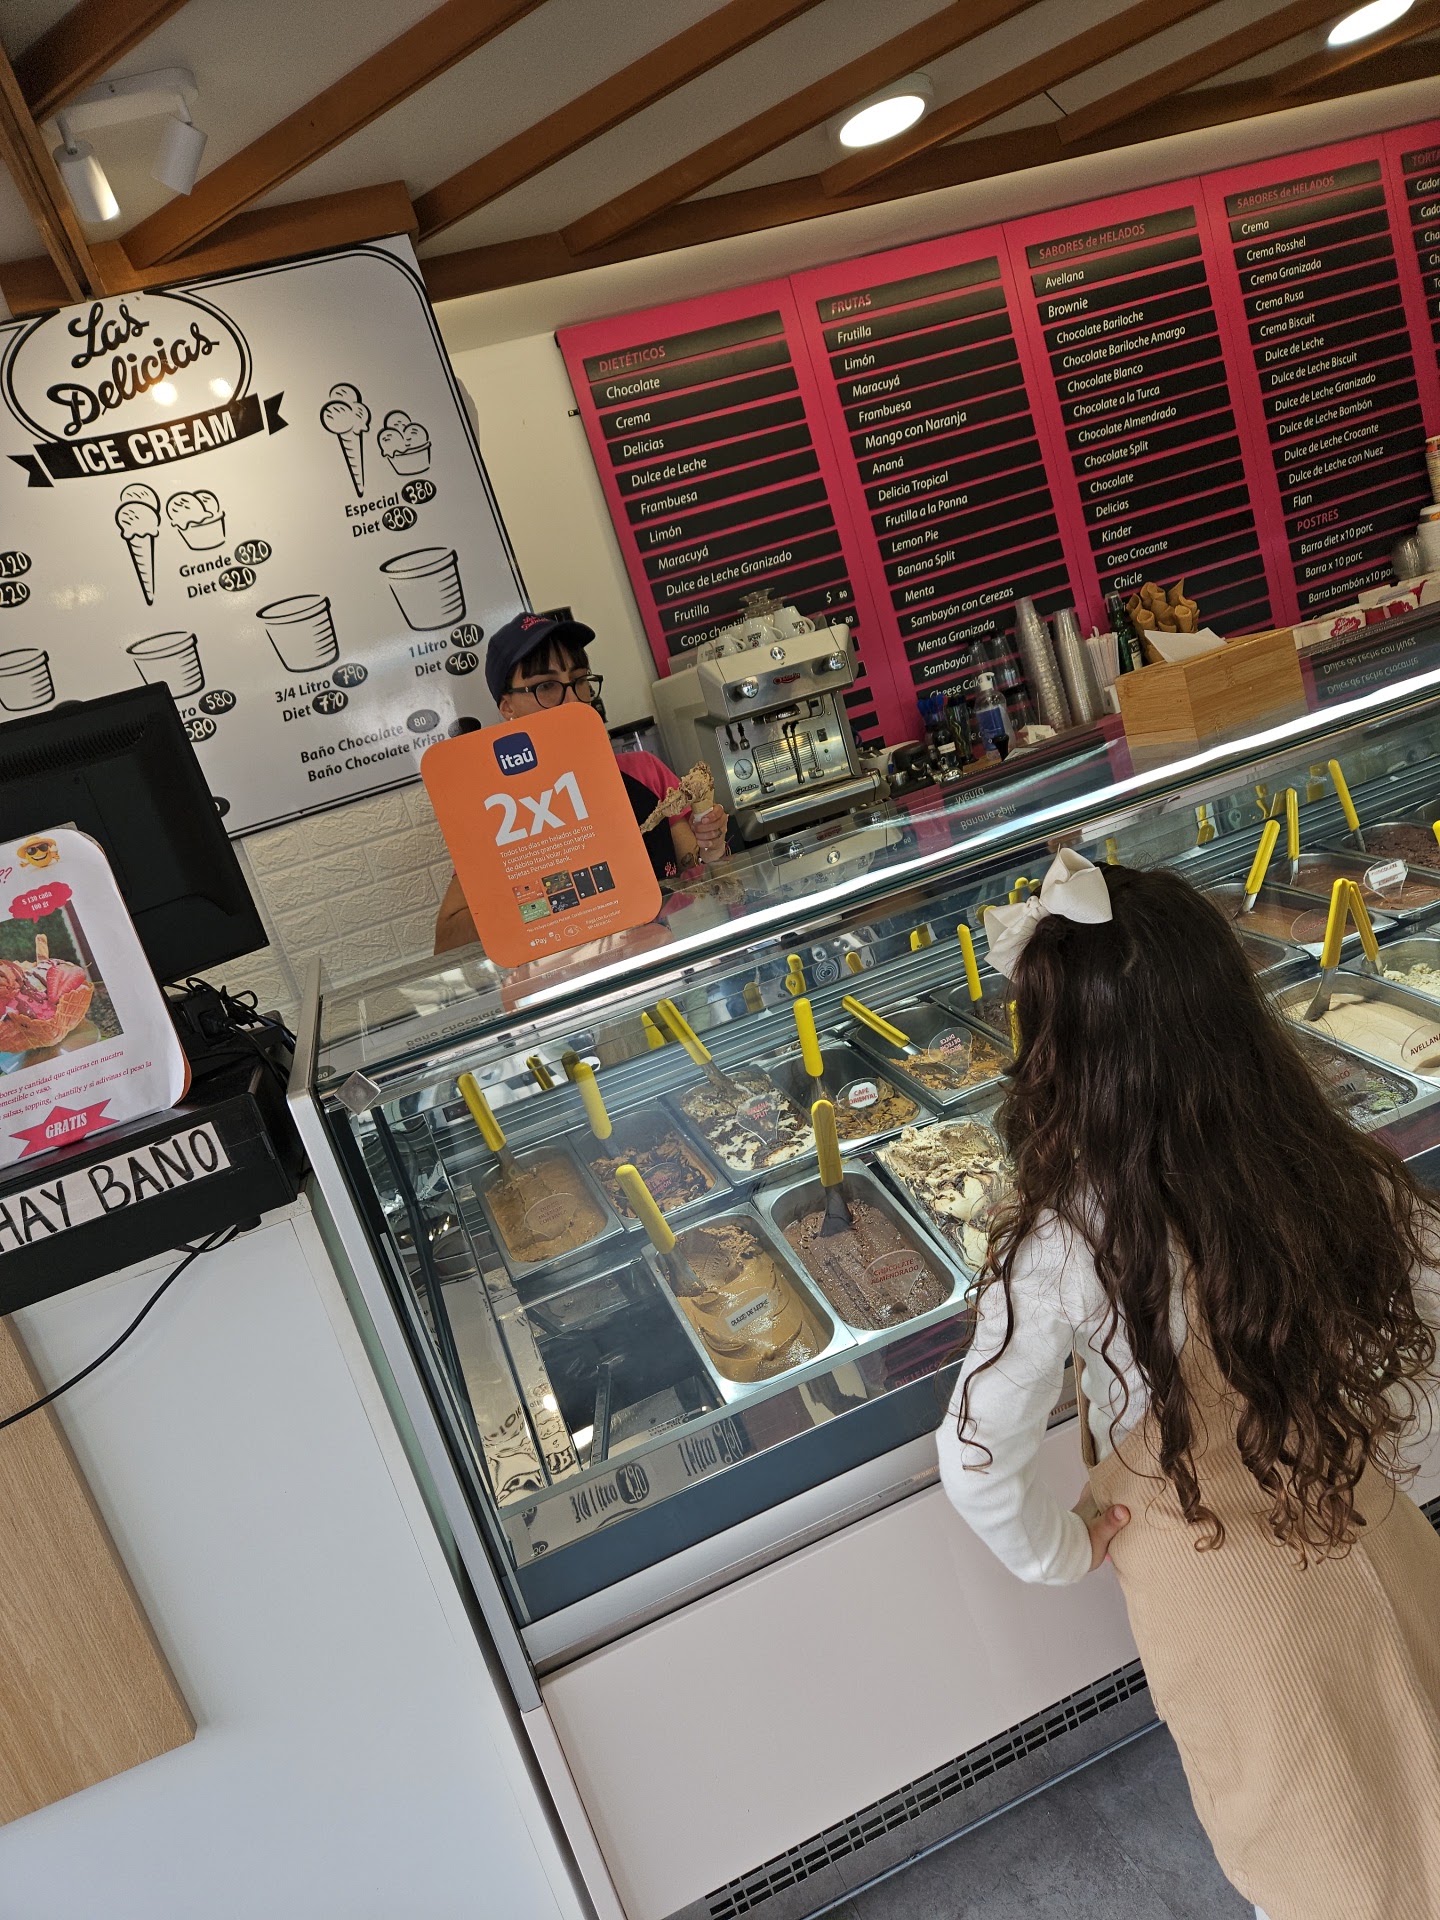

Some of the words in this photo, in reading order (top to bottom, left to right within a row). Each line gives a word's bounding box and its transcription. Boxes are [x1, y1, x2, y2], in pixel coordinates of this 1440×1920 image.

[1236, 191, 1278, 209] SABORES
[1279, 186, 1291, 198] de
[1292, 177, 1338, 197] HELADOS
[1240, 220, 1269, 234] Crema
[1038, 240, 1084, 259] SABORES
[1085, 235, 1097, 248] de
[1098, 224, 1147, 244] HELADOS
[1245, 246, 1274, 261] Crema
[1274, 235, 1306, 253] Rosshel
[1044, 270, 1084, 288] Avellana
[1249, 271, 1278, 286] Crema
[1278, 258, 1321, 278] Granizada
[830, 296, 871, 313] FRUTAS
[1047, 296, 1088, 318] Brownie
[1254, 296, 1283, 311] Crema
[1283, 290, 1304, 303] Rusa
[67, 301, 150, 369] Las
[837, 324, 872, 343] Frutilla
[1055, 323, 1101, 344] Chocolate
[1102, 310, 1144, 331] Bariloche
[1259, 321, 1287, 337] Crema
[1287, 312, 1315, 329] Biscuit
[598, 346, 666, 372] DIETÉTICOS
[1062, 348, 1107, 368] Chocolate
[1108, 335, 1149, 355] Bariloche
[1150, 325, 1186, 343] Amargo
[844, 353, 875, 371] Limón
[46, 321, 220, 437] Delicias
[605, 377, 660, 399] Chocolate
[852, 373, 900, 397] Maracuyá
[1066, 372, 1112, 393] Chocolate
[1112, 363, 1143, 380] Blanco
[615, 411, 651, 429] Crema
[858, 399, 911, 423] Frambuesa
[1077, 422, 1122, 442] Chocolate
[1123, 405, 1177, 430] Almendrado
[71, 439, 126, 474] ICE
[127, 410, 237, 465] CREAM
[864, 429, 903, 449] Mango
[903, 423, 923, 437] con
[924, 410, 967, 432] Naranja
[622, 438, 664, 457] Delicias
[1083, 447, 1128, 468] Chocolate
[1128, 440, 1148, 456] Split
[630, 470, 661, 487] Dulce
[662, 465, 676, 478] de
[676, 457, 707, 475] Leche
[871, 455, 904, 475] Ananá
[877, 483, 910, 501] Delicia
[910, 470, 948, 491] Tropical
[1089, 472, 1134, 493] Chocolate
[344, 491, 400, 518] Especial
[404, 481, 434, 505] 380
[640, 490, 698, 515] Frambuesa
[884, 508, 918, 527] Frutilla
[918, 507, 926, 516] a
[926, 502, 936, 514] la
[937, 494, 968, 511] Panna
[1095, 499, 1129, 517] Delicias
[1292, 493, 1312, 508] Flan
[351, 520, 381, 538] Diet
[384, 506, 415, 530] 380
[1101, 525, 1132, 542] Kinder
[1296, 510, 1339, 531] POSTRES
[648, 525, 682, 543] Limón
[891, 535, 923, 553] Lemon
[924, 529, 938, 542] Pie
[178, 554, 233, 578] Grande
[238, 540, 270, 564] 320
[658, 544, 709, 570] Maracuyá
[896, 558, 933, 577] Banana
[934, 550, 955, 566] Split
[1106, 552, 1129, 566] Oreo
[1129, 540, 1168, 559] Crocante
[1304, 563, 1327, 578] Barra
[1327, 561, 1333, 570] x
[1334, 555, 1344, 567] 10
[1344, 550, 1363, 566] porc
[186, 580, 218, 599] Diet
[221, 567, 254, 592] 320
[665, 580, 695, 596] Dulce
[696, 574, 709, 587] de
[710, 566, 739, 583] Leche
[740, 549, 792, 574] Granizado
[1113, 571, 1142, 589] Chicle
[904, 585, 935, 602] Menta
[673, 603, 709, 622] Frutilla
[910, 604, 960, 628] Sambayón
[960, 598, 978, 611] con
[978, 586, 1014, 605] Cerezas
[408, 644, 416, 659] 1
[416, 639, 448, 657] Litro
[451, 624, 479, 648] 960
[917, 635, 947, 652] Menta
[947, 619, 995, 642] Granizada
[414, 660, 442, 678] Diet
[448, 652, 478, 672] 960
[274, 686, 297, 704] 3/4
[298, 679, 331, 697] Litro
[337, 665, 365, 686] 790
[282, 704, 312, 723] Diet
[299, 745, 336, 764] Baño
[337, 724, 404, 752] Chocolate
[412, 716, 427, 727] 80
[307, 763, 343, 783] Baño
[344, 744, 411, 771] Chocolate
[411, 733, 446, 752] Krisp
[500, 749, 534, 770] itaú
[483, 770, 590, 847] 2x1
[17, 1085, 23, 1094] y
[23, 1074, 52, 1090] cantidad
[52, 1071, 65, 1080] que
[65, 1062, 90, 1075] quieras
[89, 1058, 99, 1066] en
[99, 1050, 124, 1063] nuestra
[2, 1107, 24, 1119] salsas,
[24, 1097, 52, 1111] topping,
[54, 1085, 83, 1101] chantilly
[83, 1082, 88, 1091] y
[94, 1071, 122, 1086] adivinas
[121, 1067, 129, 1076] el
[129, 1063, 145, 1075] peso
[45, 1112, 88, 1139] GRATIS
[0, 1180, 72, 1251] HAY
[870, 1264, 920, 1286] ALMENDRADO
[872, 1257, 915, 1277] CHOCOLATE
